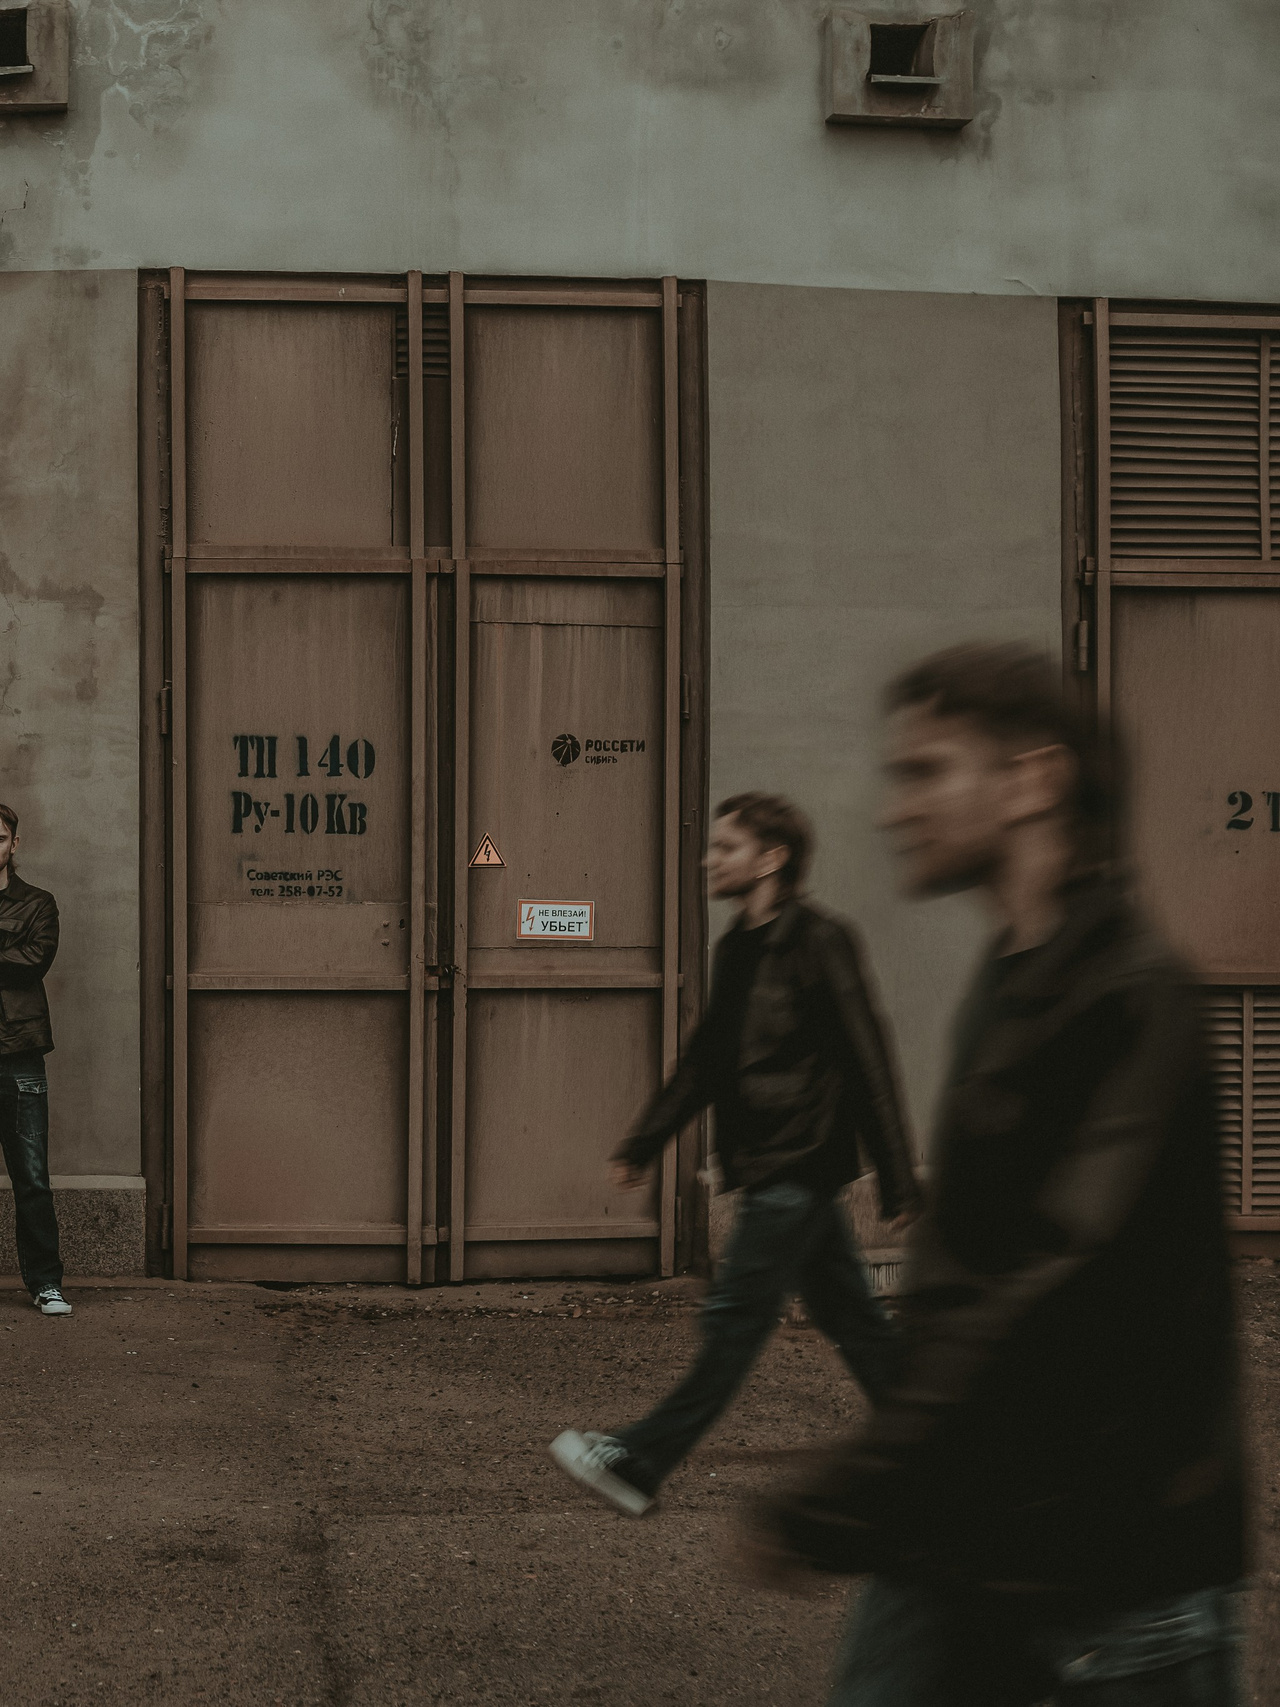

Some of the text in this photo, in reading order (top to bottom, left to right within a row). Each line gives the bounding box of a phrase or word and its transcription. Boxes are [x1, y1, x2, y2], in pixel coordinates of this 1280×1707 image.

[585, 739, 646, 753] РОССЕТИ
[234, 735, 376, 779] ТП 140
[585, 755, 618, 764] СИБИРЬ
[246, 869, 344, 882] Советский РЭС
[251, 885, 344, 897] тел: 258-07-52
[538, 908, 587, 918] НЕ ВЛЕЗАЙ!
[540, 920, 584, 932] УБЬЕТ
